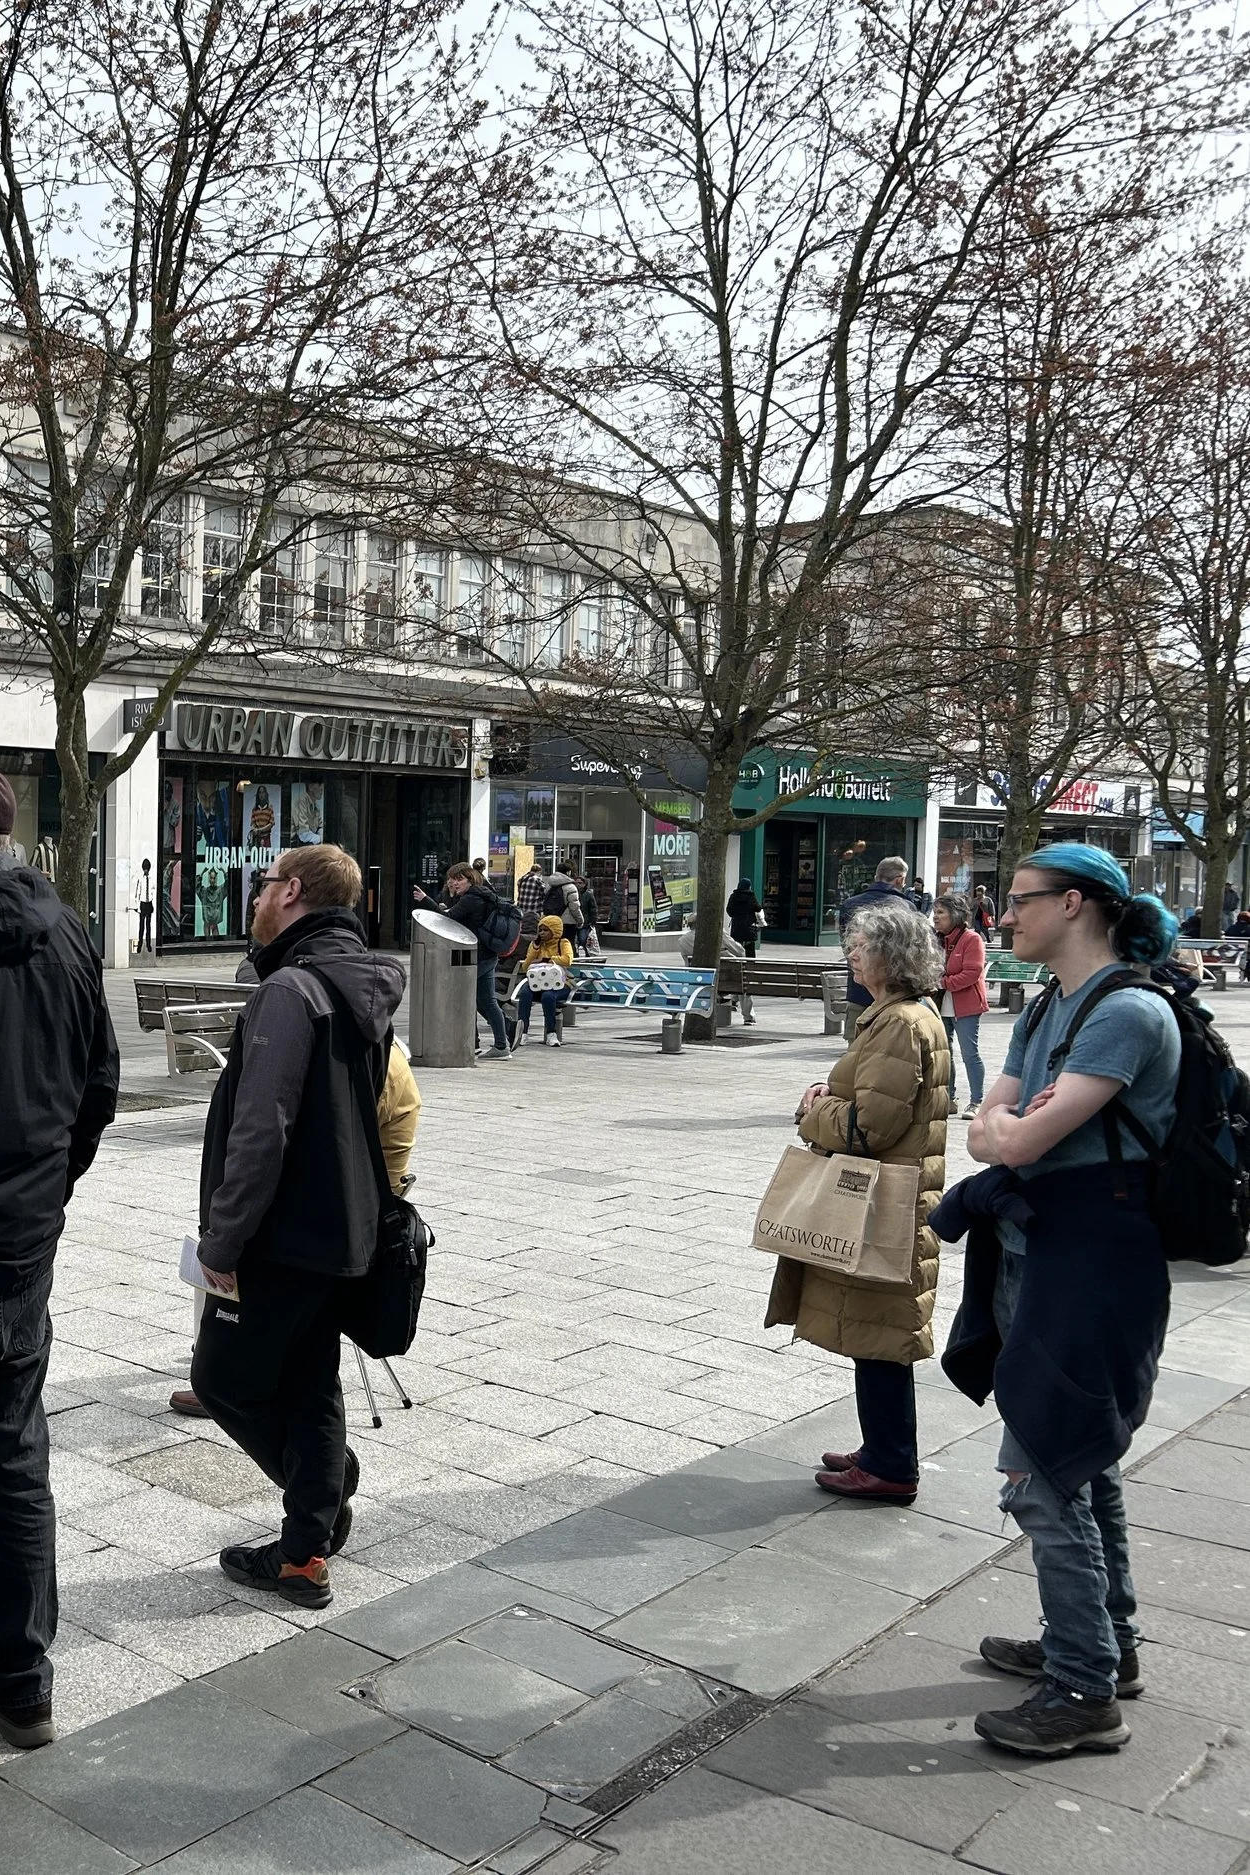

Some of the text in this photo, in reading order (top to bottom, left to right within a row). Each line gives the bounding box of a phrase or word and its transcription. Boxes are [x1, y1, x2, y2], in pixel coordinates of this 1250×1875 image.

[135, 702, 155, 714] RIVE
[178, 704, 467, 768] URBAN OUTFITTERS
[653, 834, 691, 856] MORE
[204, 846, 246, 868] URBAN
[758, 1218, 856, 1257] CHATSWORTH
